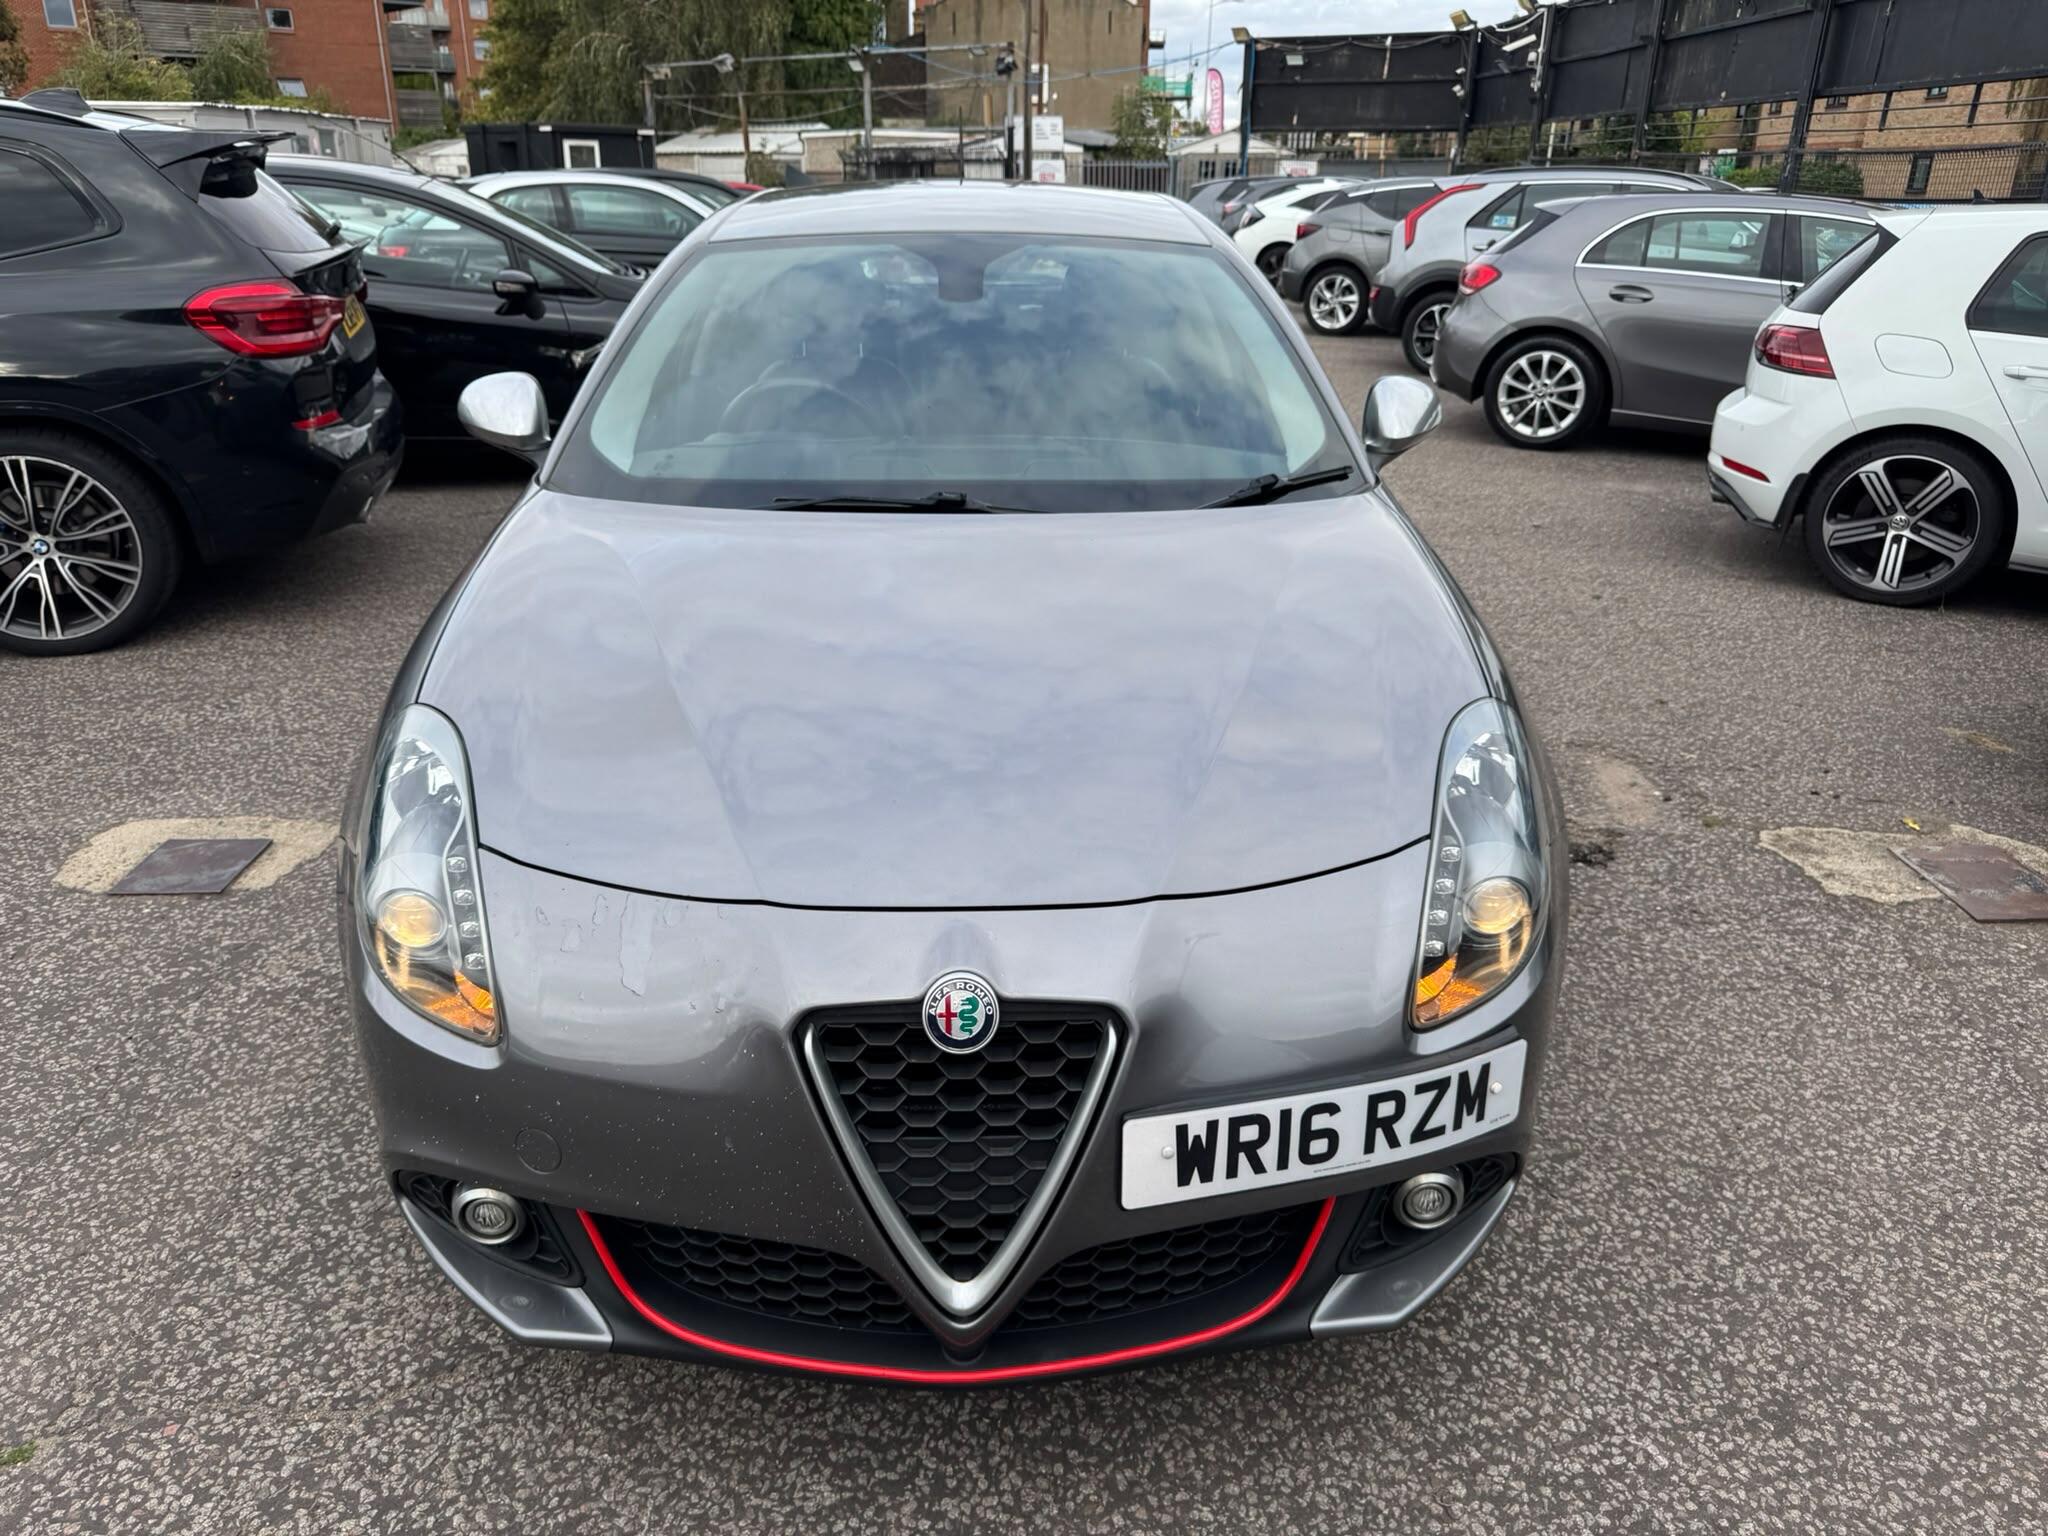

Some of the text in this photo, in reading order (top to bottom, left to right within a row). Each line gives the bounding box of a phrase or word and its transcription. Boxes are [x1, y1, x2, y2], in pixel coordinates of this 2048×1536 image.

[929, 982, 993, 1016] ALFA ROMEO
[1175, 1061, 1491, 1188] WR16 RZM
